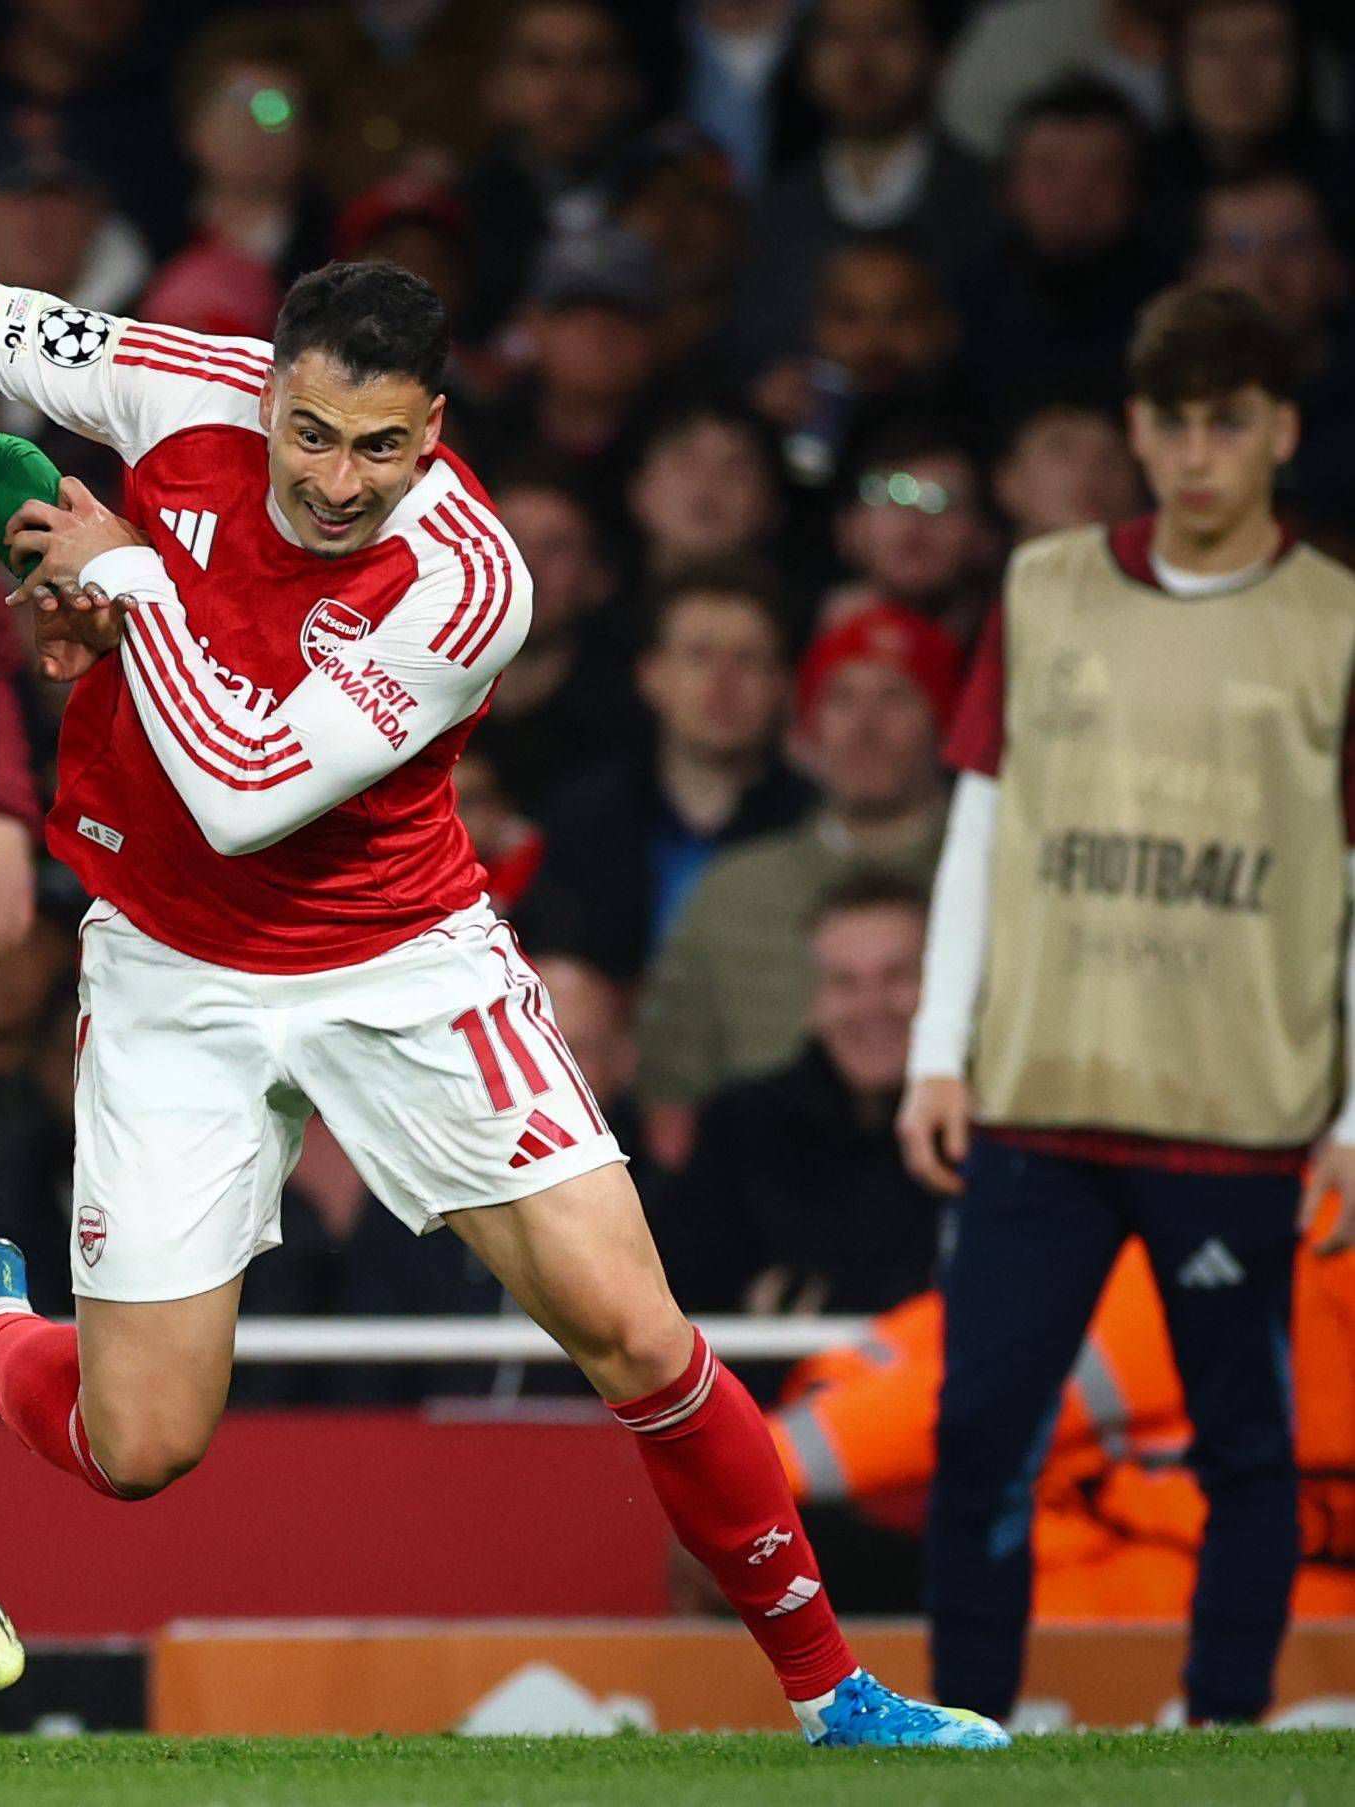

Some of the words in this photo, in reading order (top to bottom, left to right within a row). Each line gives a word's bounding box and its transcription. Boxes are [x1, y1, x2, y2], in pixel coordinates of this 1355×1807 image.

[317, 609, 360, 636] Arsenal
[320, 656, 409, 752] RWANDA
[361, 659, 419, 714] VISIT
[448, 994, 553, 1116] 11
